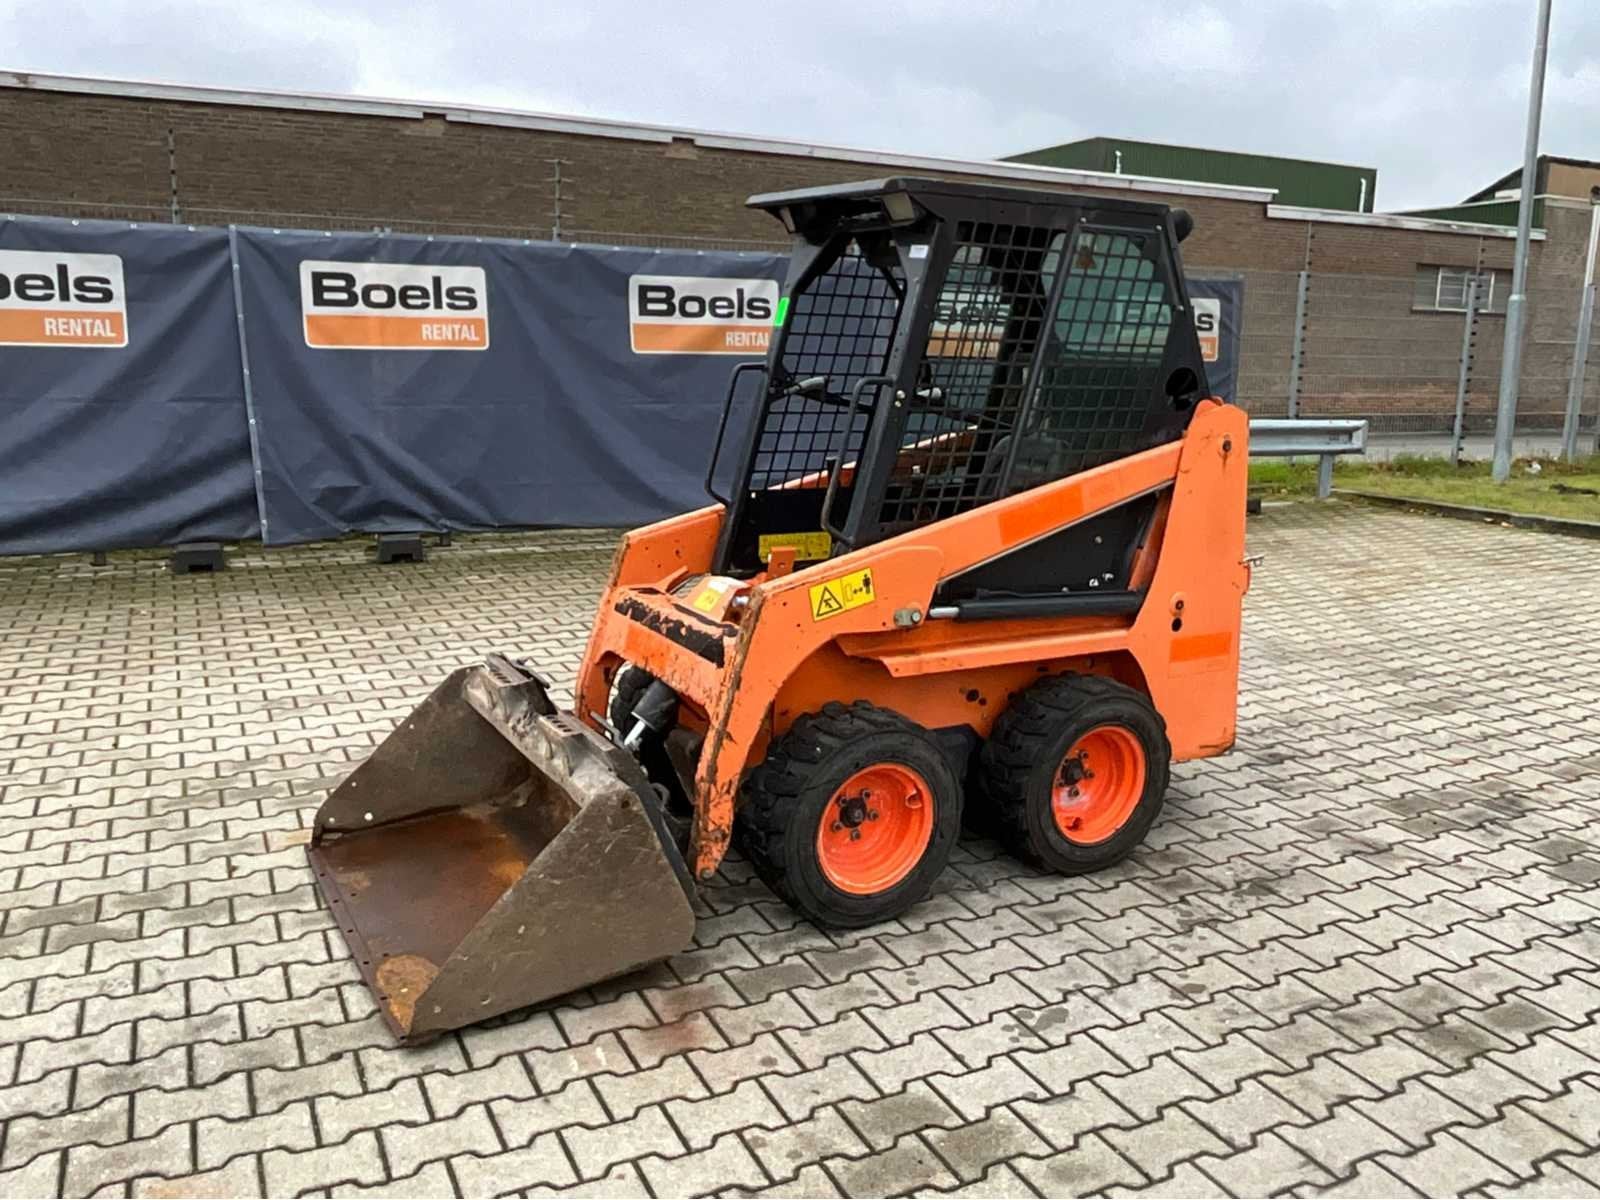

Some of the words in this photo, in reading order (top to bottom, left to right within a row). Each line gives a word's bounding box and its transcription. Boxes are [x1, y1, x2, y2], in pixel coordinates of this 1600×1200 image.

[311, 271, 478, 311] Boels
[638, 284, 771, 320] Boels
[44, 317, 117, 337] RENTAL
[421, 323, 480, 342] RENTAL
